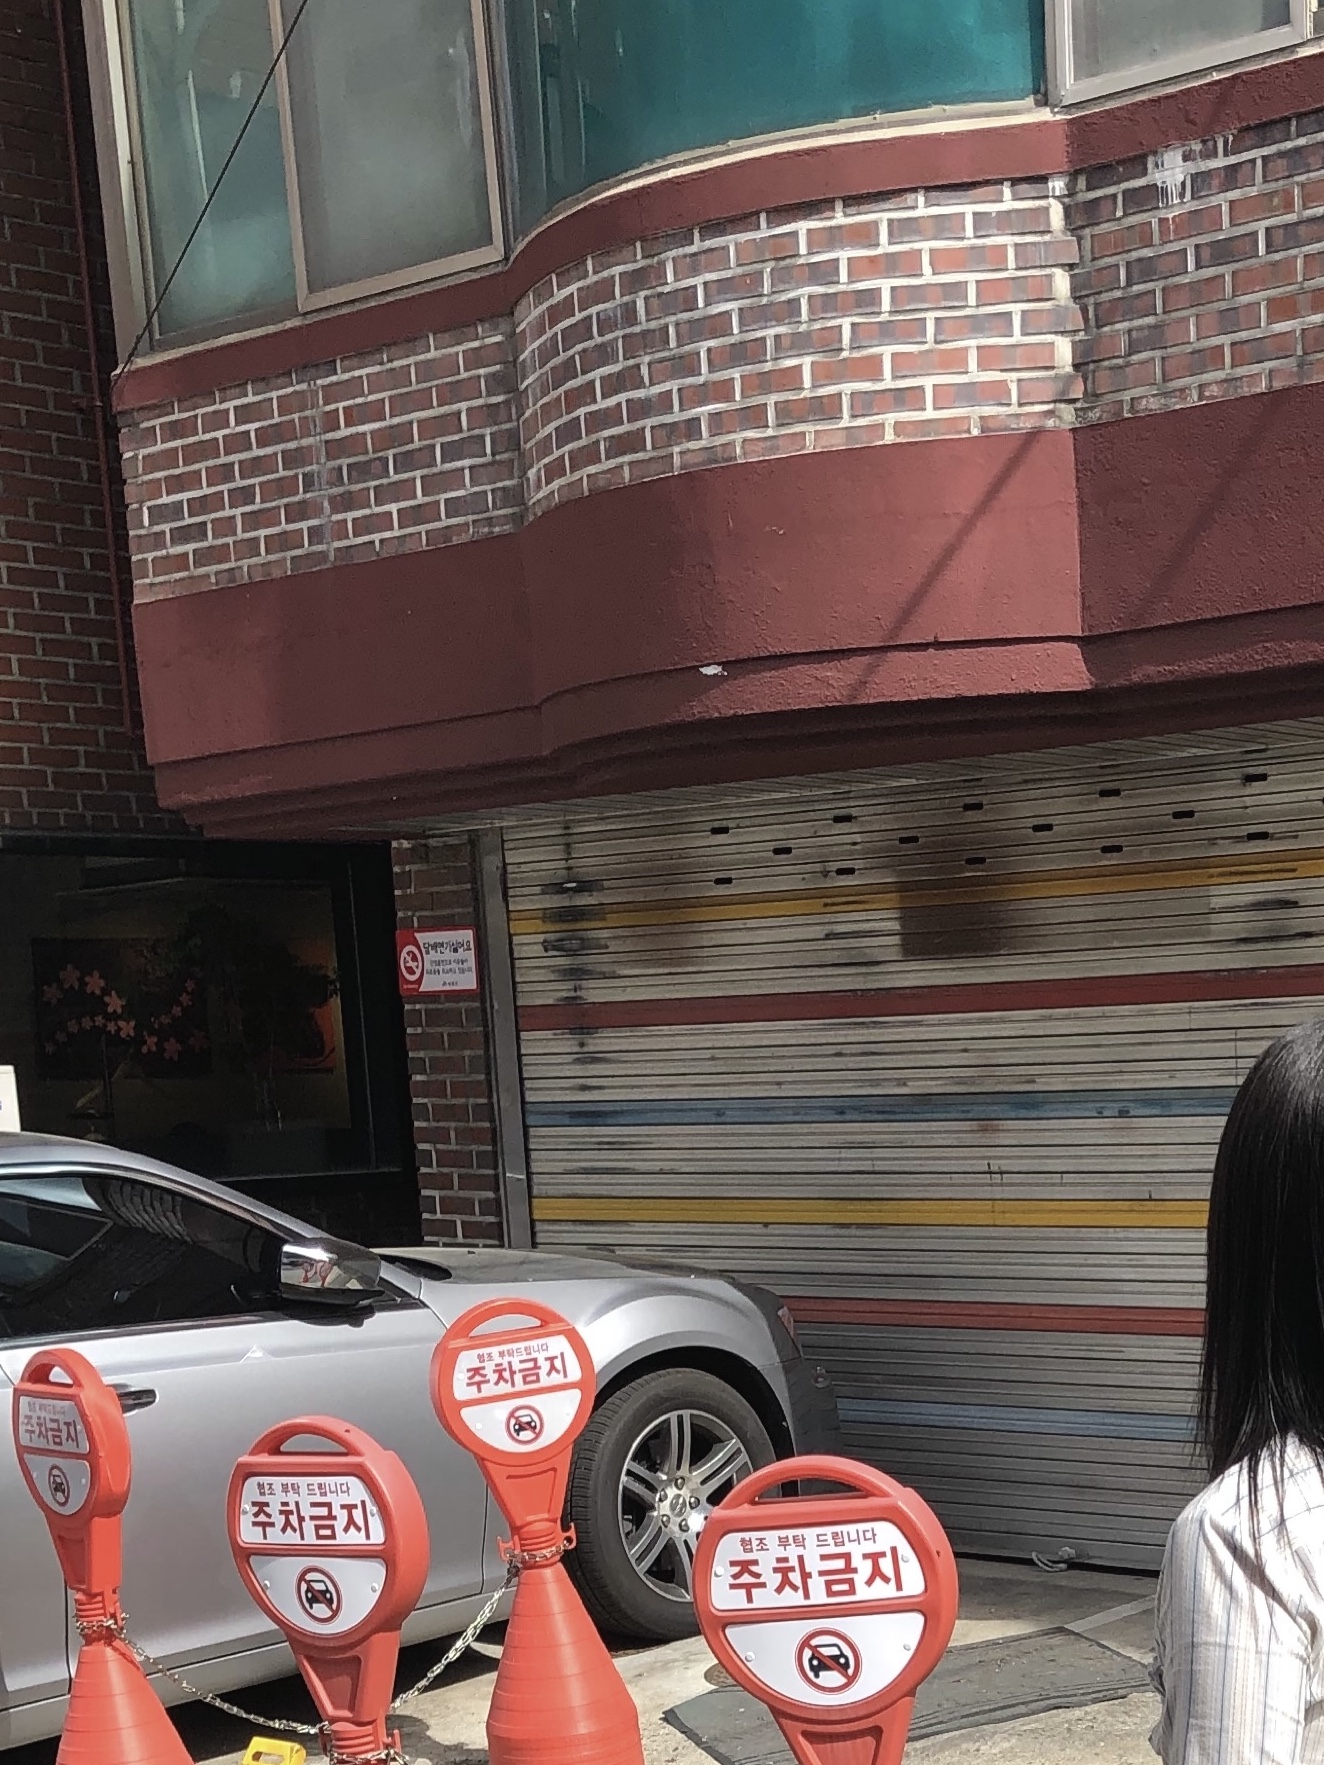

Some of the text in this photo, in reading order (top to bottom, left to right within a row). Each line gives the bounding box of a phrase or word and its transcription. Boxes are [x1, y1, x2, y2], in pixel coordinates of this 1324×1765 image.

[466, 1351, 569, 1394] 주차금지
[21, 1415, 80, 1449] 주차금지
[257, 1481, 351, 1498] 협조 부탁 드립니다
[250, 1499, 372, 1542] 주차금지
[739, 1526, 878, 1553] 협조 부탁 드립니다
[728, 1545, 904, 1605] 주차금지
